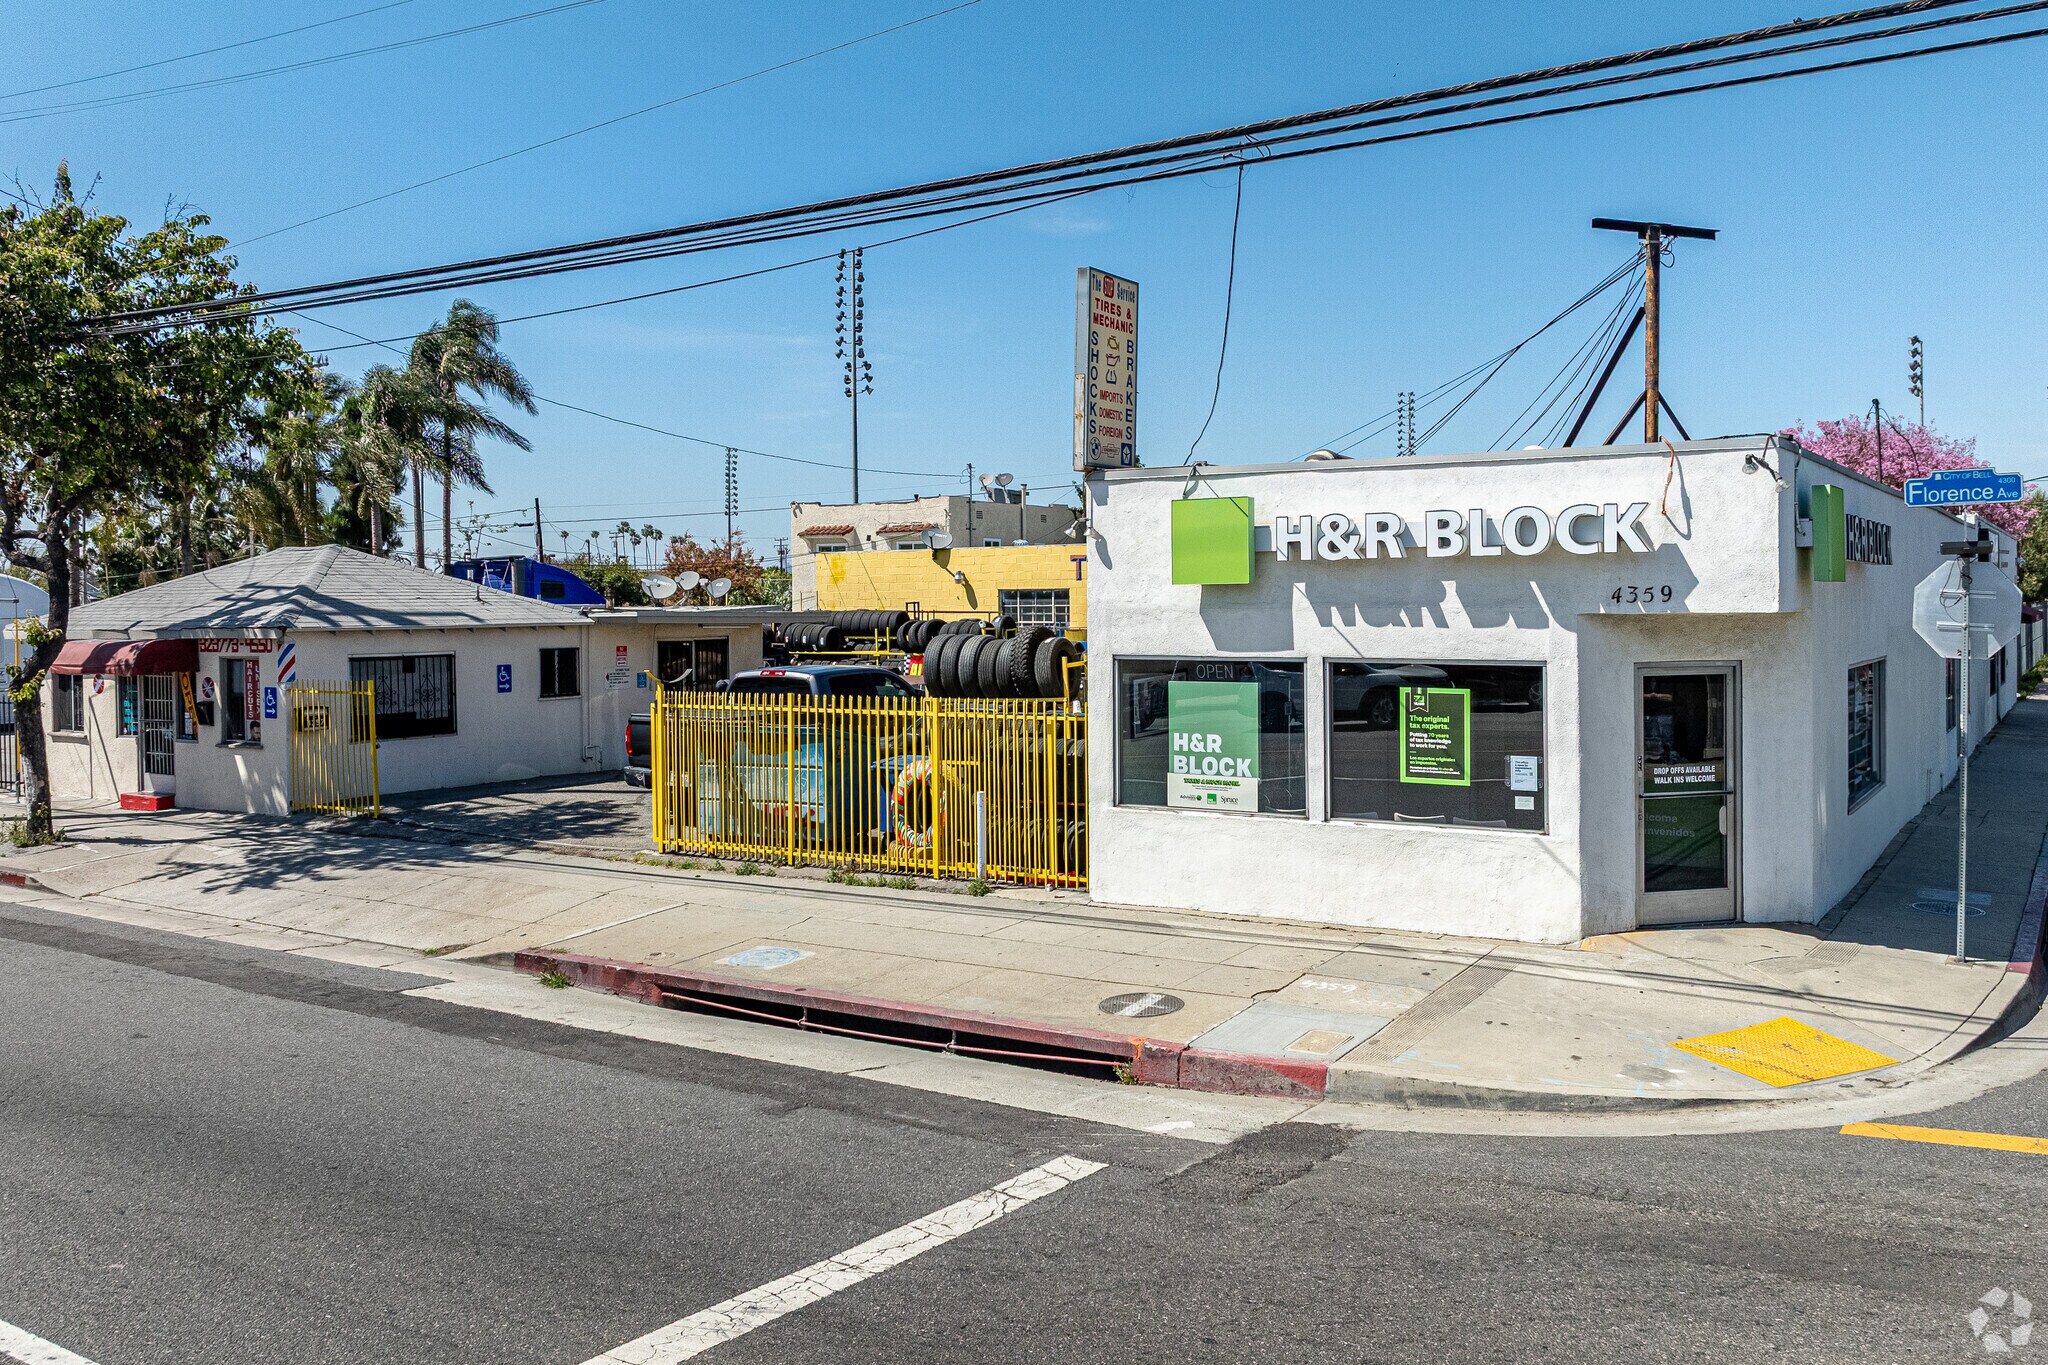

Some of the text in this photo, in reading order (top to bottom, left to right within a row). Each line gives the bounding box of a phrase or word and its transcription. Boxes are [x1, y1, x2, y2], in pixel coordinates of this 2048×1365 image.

[1092, 273, 1101, 292] The
[1117, 282, 1135, 303] Service
[1095, 297, 1132, 320] TIRES &
[1093, 312, 1133, 334] MECHANIC
[1089, 331, 1099, 434] SHOCKS
[1125, 340, 1134, 440] BRAKES
[1100, 390, 1124, 404] IMPORTS
[1099, 407, 1123, 421] DOMESTIC
[1099, 425, 1123, 439] FOREIGN
[1942, 471, 1991, 480] CITY OF BELL
[1909, 482, 2018, 503] Florence Ave
[1276, 502, 1652, 562] H&R BLOCK
[1846, 514, 1893, 565] H&R BLOCK
[1611, 585, 1673, 604] 4359
[1196, 664, 1234, 679] OPEN
[246, 661, 254, 718] HAIRCUTS
[1423, 715, 1449, 723] original
[1173, 733, 1222, 753] H&R
[1173, 755, 1252, 777] BLOCK
[1670, 766, 1685, 774] OFFS
[1685, 765, 1716, 773] AVAILABLE
[1685, 775, 1716, 783] WELCOME
[1646, 813, 1677, 823] lcome
[1647, 827, 1695, 837] nvenidos
